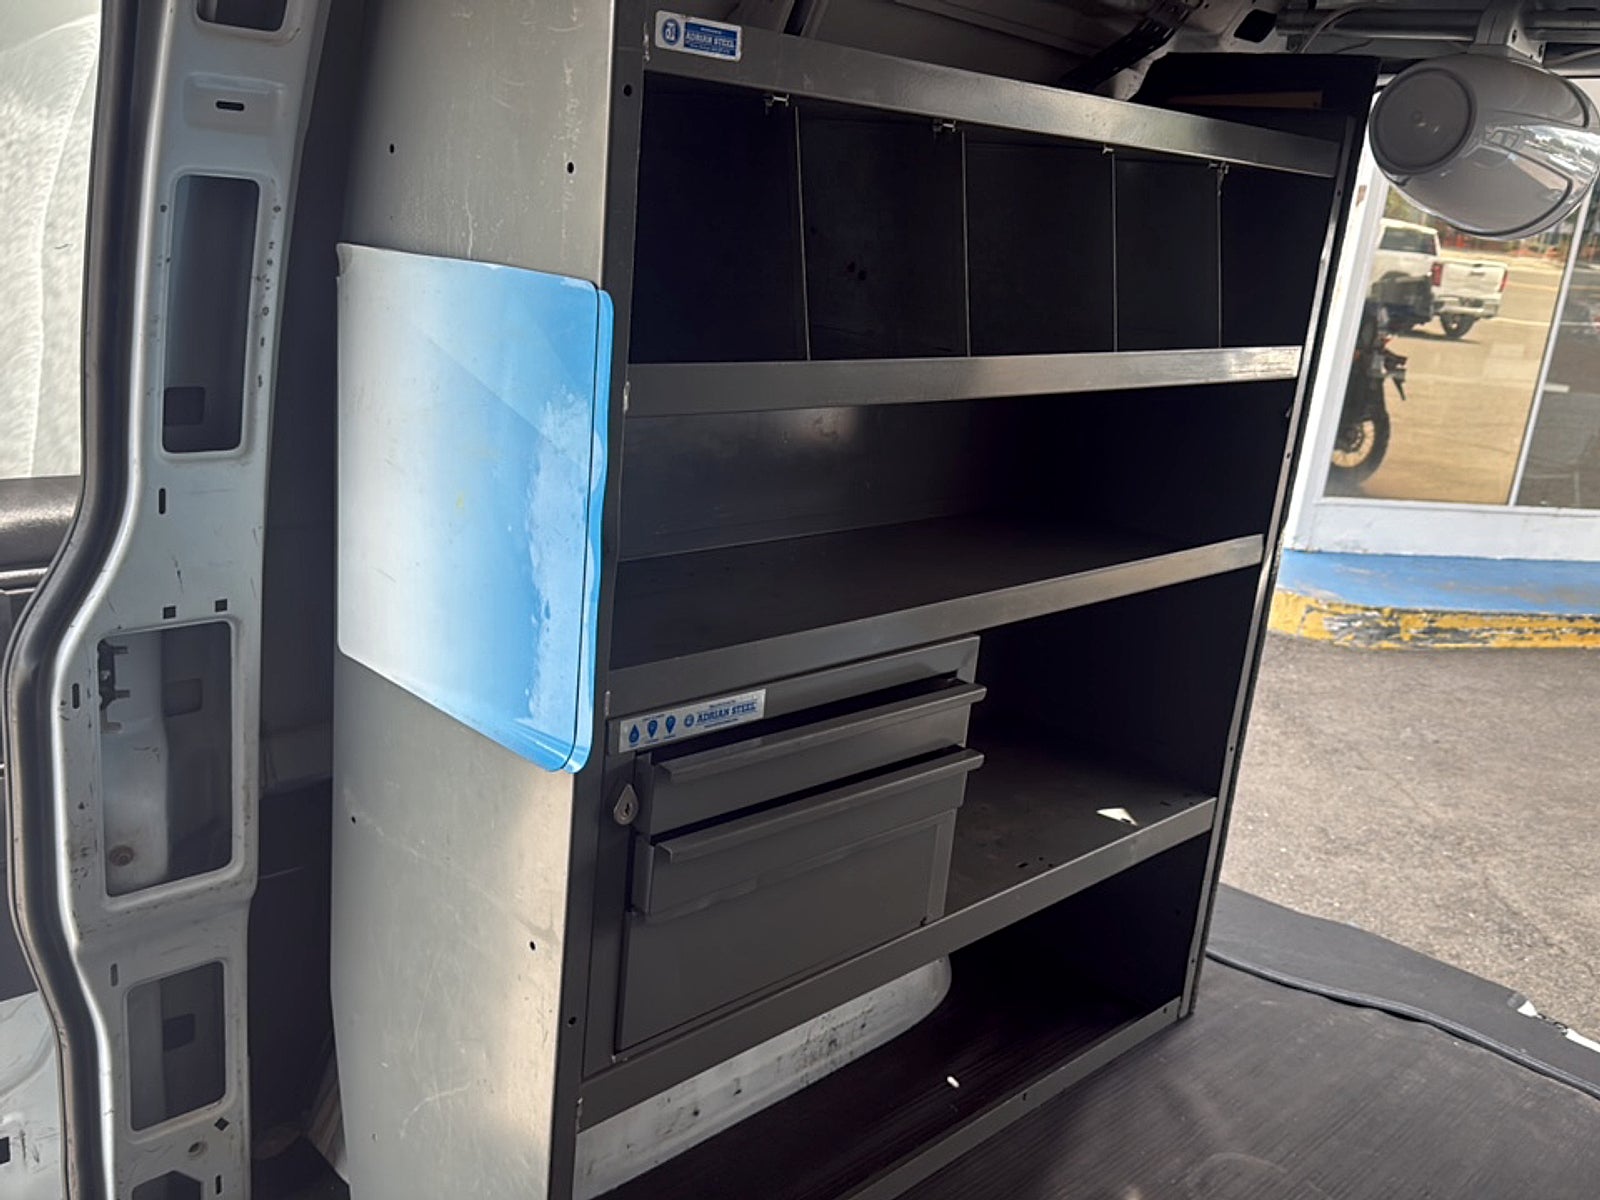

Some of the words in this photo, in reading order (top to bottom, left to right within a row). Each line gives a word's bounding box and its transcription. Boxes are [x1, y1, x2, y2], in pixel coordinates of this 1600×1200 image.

[686, 31, 712, 43] ADRIAN
[713, 37, 734, 48] STEEL
[697, 709, 729, 723] ADRIAN
[731, 701, 757, 714] STEEL
